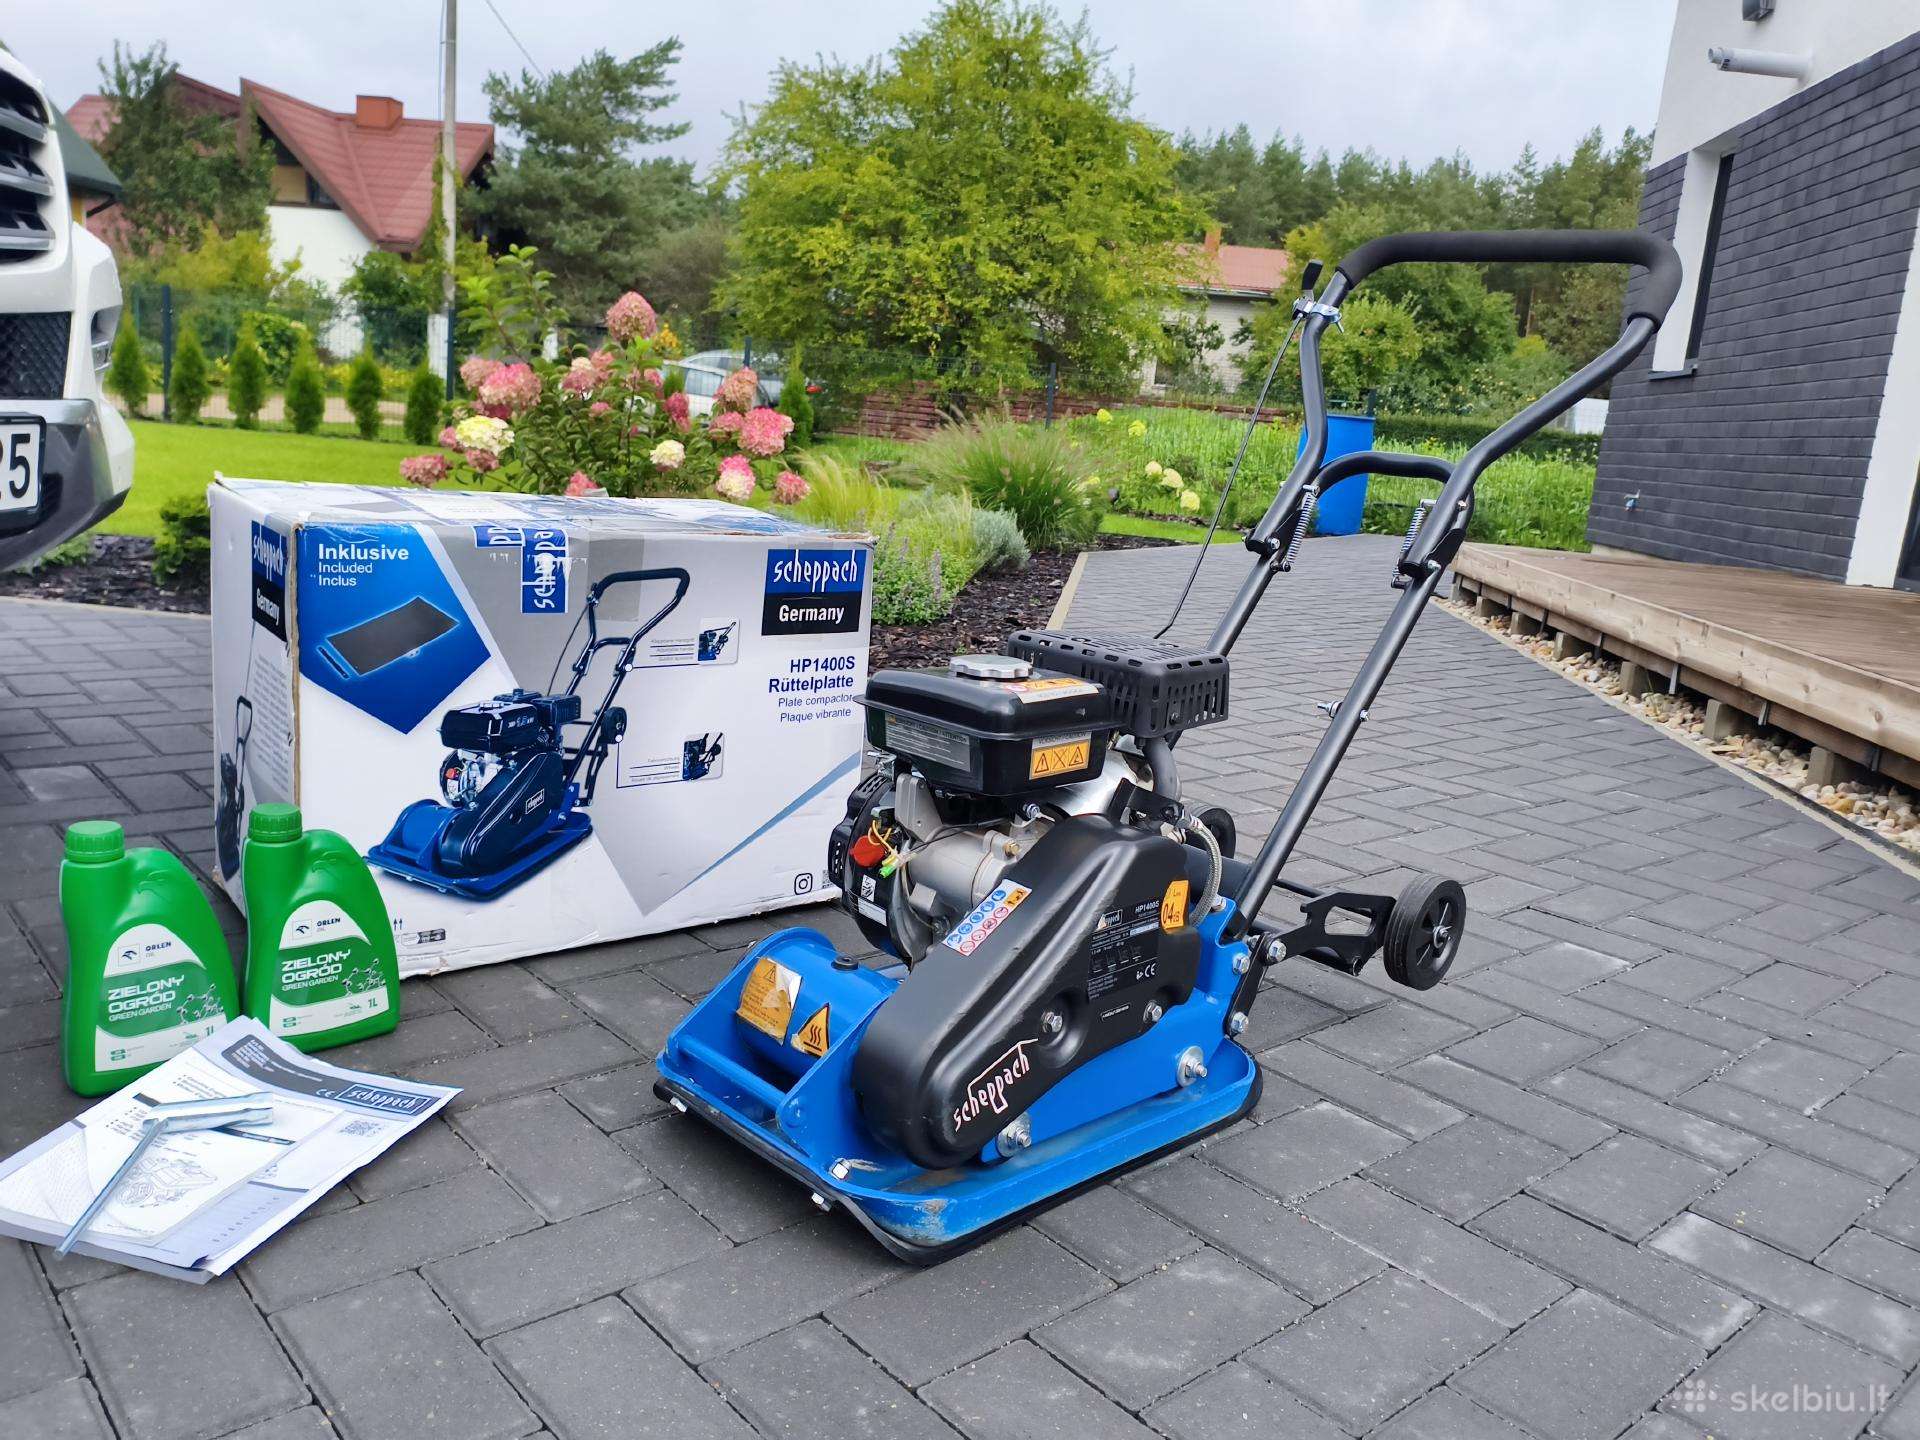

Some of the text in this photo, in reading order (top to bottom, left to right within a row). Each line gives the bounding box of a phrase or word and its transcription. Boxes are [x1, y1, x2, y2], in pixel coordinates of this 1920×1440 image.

[0, 433, 31, 499] 5
[318, 543, 409, 560] Inklusive
[318, 562, 373, 573] Included
[773, 549, 858, 592] scheppach
[318, 574, 357, 586] Inclus
[256, 587, 280, 626] Germany
[778, 604, 845, 624] Germany
[790, 655, 856, 673] HP1400S
[768, 674, 854, 693] Rüttelplatte
[778, 692, 852, 707] Plate compactor
[780, 708, 852, 723] Plaque vibrante
[316, 917, 341, 927] ORLEN
[145, 941, 172, 952] ORLEN
[281, 948, 351, 972] ZIELONY
[281, 963, 343, 984] OGRÓD
[281, 975, 339, 992] GREEN GARDEN
[108, 974, 185, 1001] ZIELONY
[108, 990, 177, 1014] OGRÓD
[108, 1002, 173, 1022] GREEN GARDEN
[953, 1040, 1031, 1132] scheppach
[346, 1088, 418, 1109] scheppach
